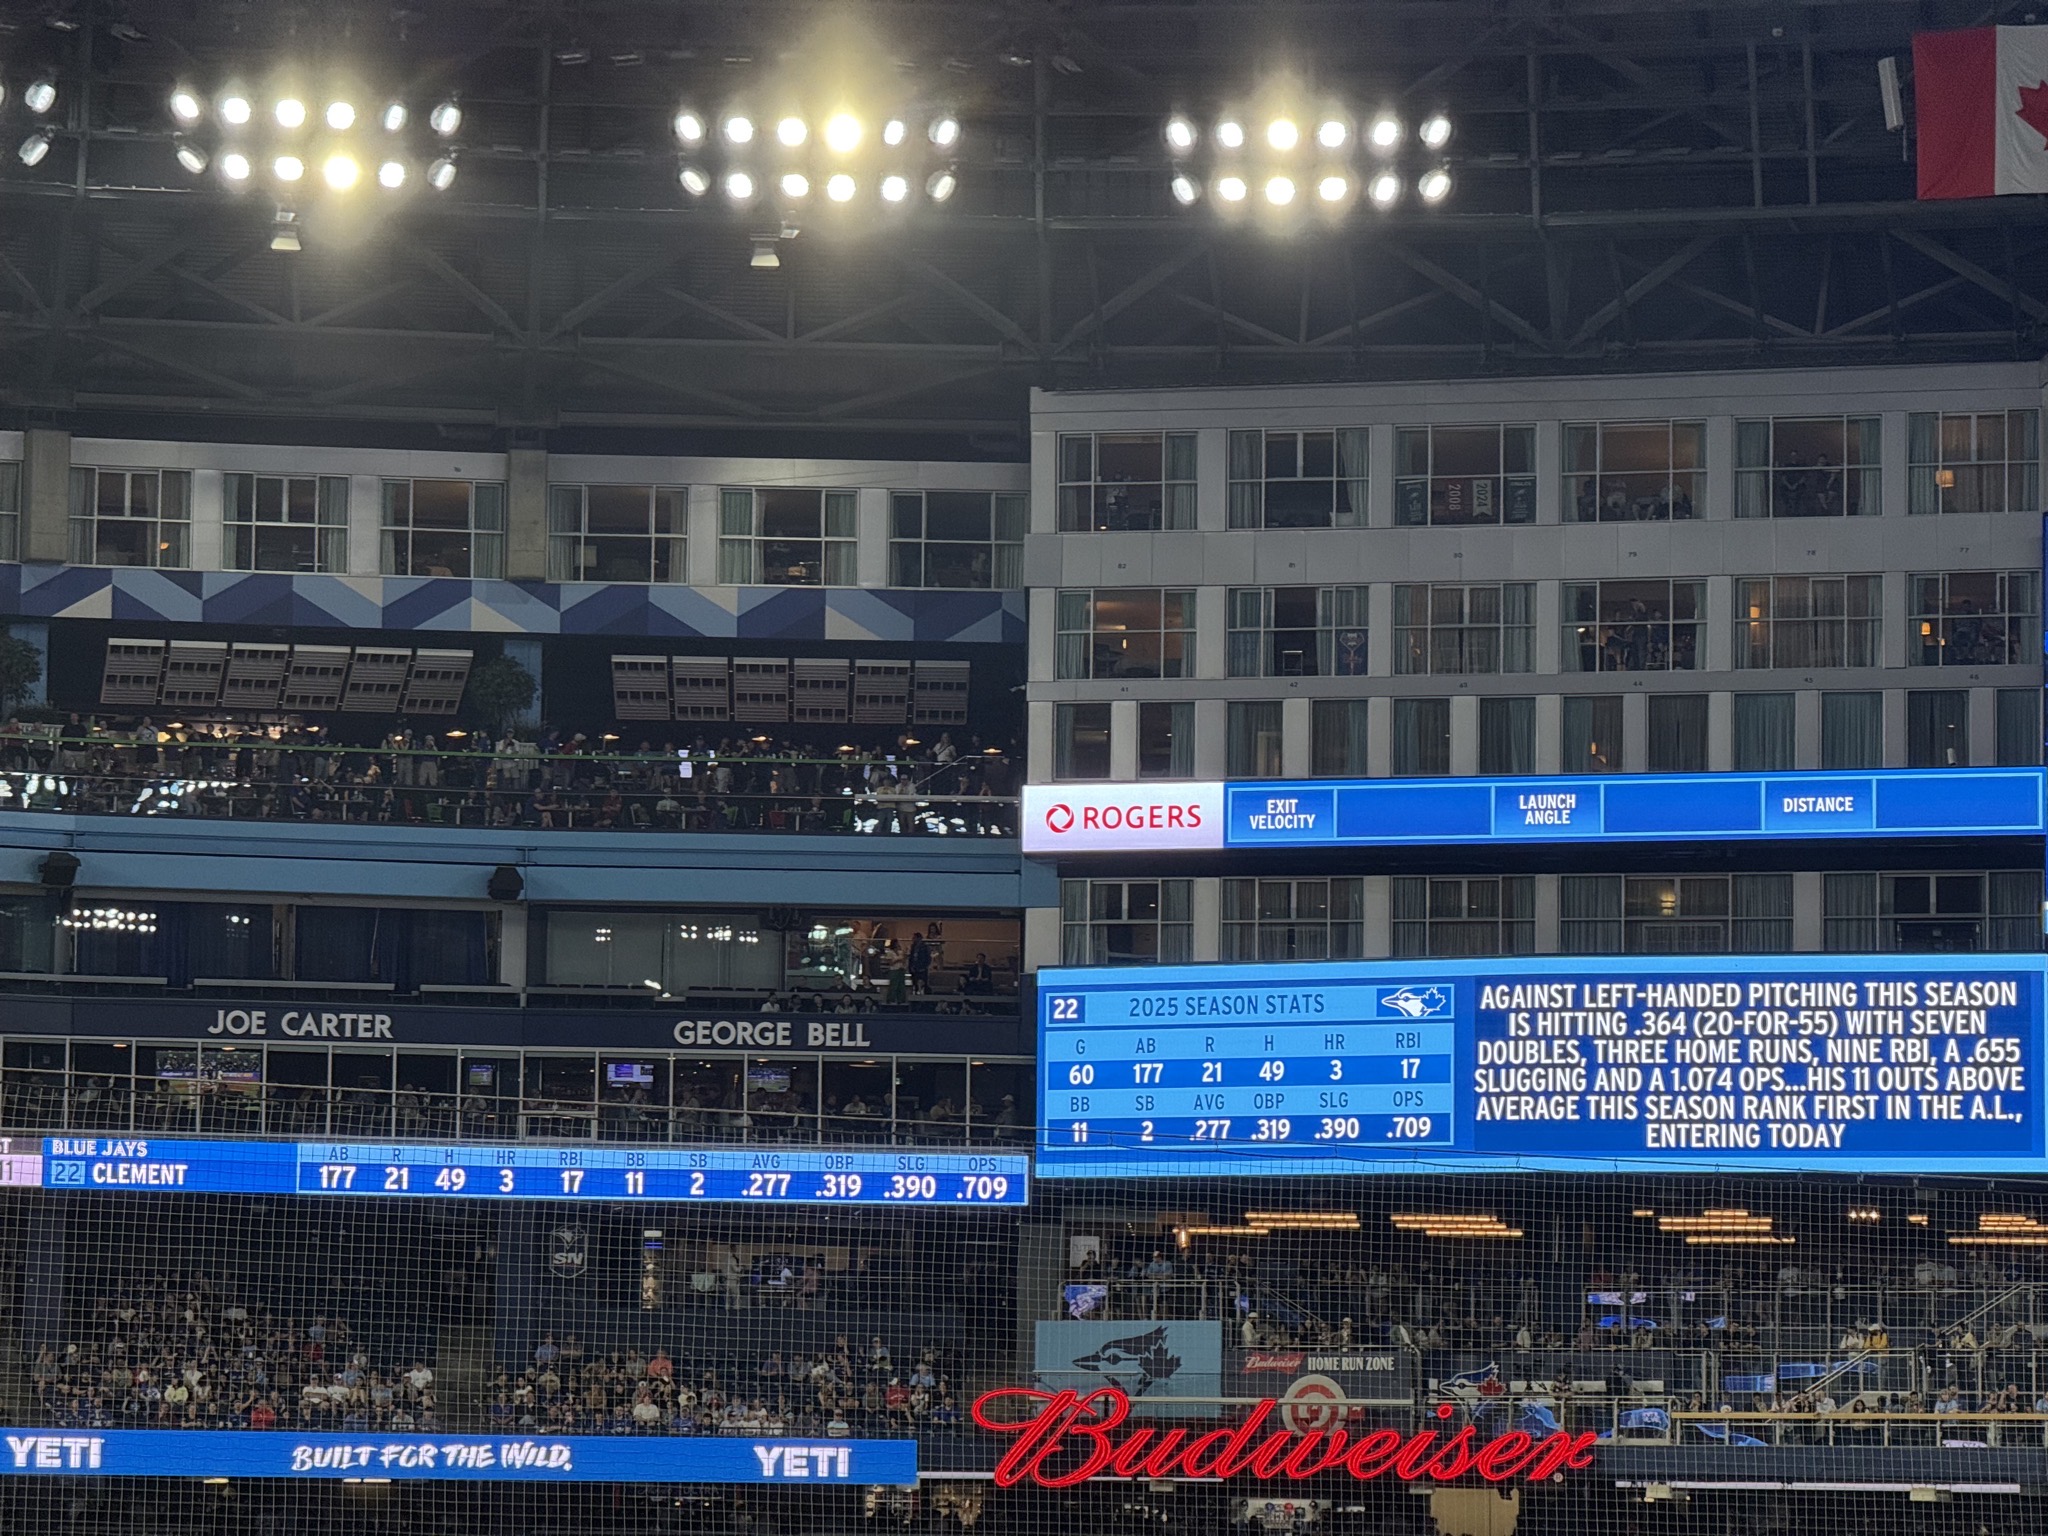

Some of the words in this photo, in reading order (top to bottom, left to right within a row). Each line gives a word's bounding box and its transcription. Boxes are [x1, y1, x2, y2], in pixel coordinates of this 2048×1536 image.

[1448, 484, 1461, 511] 2008
[1475, 483, 1489, 509] 2024
[1267, 799, 1298, 813] EXIT
[1519, 794, 1576, 809] LAUNCH
[1783, 797, 1854, 813] DISTANCE
[1083, 805, 1202, 829] ROGERS
[1250, 814, 1316, 830] VELOCITY
[1525, 809, 1571, 825] ANGLE
[1129, 997, 1179, 1017] 2025
[1185, 995, 1259, 1016] SEASON
[1266, 994, 1325, 1014] STATS
[1480, 984, 1576, 1009] AGAINST
[1585, 984, 1741, 1007] LEFT-HANDED
[1749, 982, 1857, 1007] PITCHING
[1865, 982, 1917, 1006] THIS
[1925, 982, 2016, 1006] SEASON
[1053, 998, 1078, 1021] 22
[208, 1010, 266, 1034] JOE
[281, 1012, 393, 1038] CARTER
[673, 1020, 792, 1047] GEORGE
[808, 1023, 870, 1046] BELL
[1510, 1012, 1530, 1036] IS
[1538, 1012, 1627, 1035] HITTING
[1634, 1011, 1686, 1035] .364
[1693, 1010, 1839, 1037] (20-FOR-55)
[1846, 1011, 1902, 1034] WITH
[1911, 1010, 1985, 1034] SEVEN
[1076, 1039, 1085, 1054] G
[1136, 1038, 1155, 1053] AB
[1206, 1037, 1214, 1052] R
[1265, 1035, 1273, 1051] H
[1325, 1034, 1344, 1049] HR
[1396, 1032, 1420, 1048] RBI
[1479, 1040, 1586, 1067] DOUBLES,
[1594, 1040, 1668, 1063] THREE
[1676, 1039, 1741, 1063] HOME
[1749, 1039, 1819, 1066] RUNS,
[1827, 1039, 1882, 1062] NINE
[1890, 1039, 1937, 1066] RBI,
[1944, 1039, 1960, 1062] A
[1967, 1038, 2020, 1062] .655
[1070, 1065, 1093, 1084] 60
[1134, 1064, 1163, 1083] 177
[1203, 1062, 1221, 1082] 21
[1260, 1061, 1284, 1081] 49
[1330, 1060, 1342, 1080] 3
[1401, 1059, 1420, 1078] 17
[1475, 1068, 1586, 1092] SLUGGING
[1595, 1068, 1641, 1091] AND
[1649, 1068, 1665, 1091] A
[1671, 1067, 1732, 1091] 1.074
[1739, 1067, 1845, 1091] OPS...HIS
[1852, 1067, 1869, 1091] 11
[1878, 1067, 1938, 1091] OUTS
[1945, 1067, 2024, 1091] ABOVE
[1071, 1097, 1089, 1112] BB
[1136, 1096, 1154, 1111] SB
[1194, 1094, 1224, 1110] AVG
[1254, 1093, 1284, 1109] OBP
[1320, 1092, 1348, 1108] SLG
[1393, 1091, 1423, 1107] OPS
[1476, 1096, 1579, 1120] AVERAGE
[1586, 1095, 1638, 1119] THIS
[1645, 1095, 1734, 1119] SEASON
[1744, 1095, 1806, 1119] RANK
[1815, 1095, 1879, 1119] FIRST
[1887, 1095, 1910, 1119] IN
[1918, 1095, 1963, 1119] THE
[1970, 1095, 2022, 1122] A.L.,
[1072, 1122, 1087, 1142] 11
[1142, 1121, 1153, 1141] 2
[1190, 1120, 1230, 1140] .277
[1251, 1119, 1290, 1140] .319
[1315, 1118, 1359, 1139] .390
[1387, 1117, 1431, 1138] .709
[1647, 1123, 1760, 1147] ENTERING
[1768, 1123, 1845, 1148] TODAY
[53, 1138, 96, 1155] BLUE
[102, 1140, 147, 1157] JAYS
[330, 1147, 348, 1160] AB
[392, 1148, 401, 1162] R
[445, 1149, 453, 1163] H
[497, 1150, 515, 1163] HR
[560, 1153, 582, 1166] RBI
[627, 1153, 644, 1166] BB
[690, 1154, 706, 1167] SB
[752, 1155, 780, 1169] AVG
[825, 1156, 852, 1169] OBP
[898, 1157, 924, 1170] SLG
[969, 1158, 996, 1172] OPS
[55, 1162, 80, 1182] 22
[93, 1163, 187, 1184] CLEMENT
[320, 1165, 356, 1188] 177
[385, 1167, 408, 1189] 21
[435, 1168, 465, 1190] 49
[499, 1169, 513, 1192] 3
[561, 1171, 584, 1193] 17
[625, 1172, 643, 1194] 11
[691, 1172, 704, 1195] 2
[742, 1173, 791, 1196] .277
[816, 1174, 861, 1197] .319
[884, 1175, 936, 1198] .390
[957, 1176, 1007, 1199] .709
[553, 1252, 584, 1265] SN
[1245, 1356, 1302, 1369] Budweiser
[1307, 1357, 1340, 1370] HOME
[1341, 1357, 1360, 1370] RUN
[1365, 1357, 1395, 1370] ZONE
[972, 1387, 1597, 1488] Budweiser
[6, 1436, 102, 1468] YETI
[291, 1445, 378, 1471] BUILT
[379, 1445, 438, 1469] FOR
[441, 1443, 496, 1469] THE
[500, 1441, 573, 1472] WILD.
[753, 1445, 849, 1478] YETI
